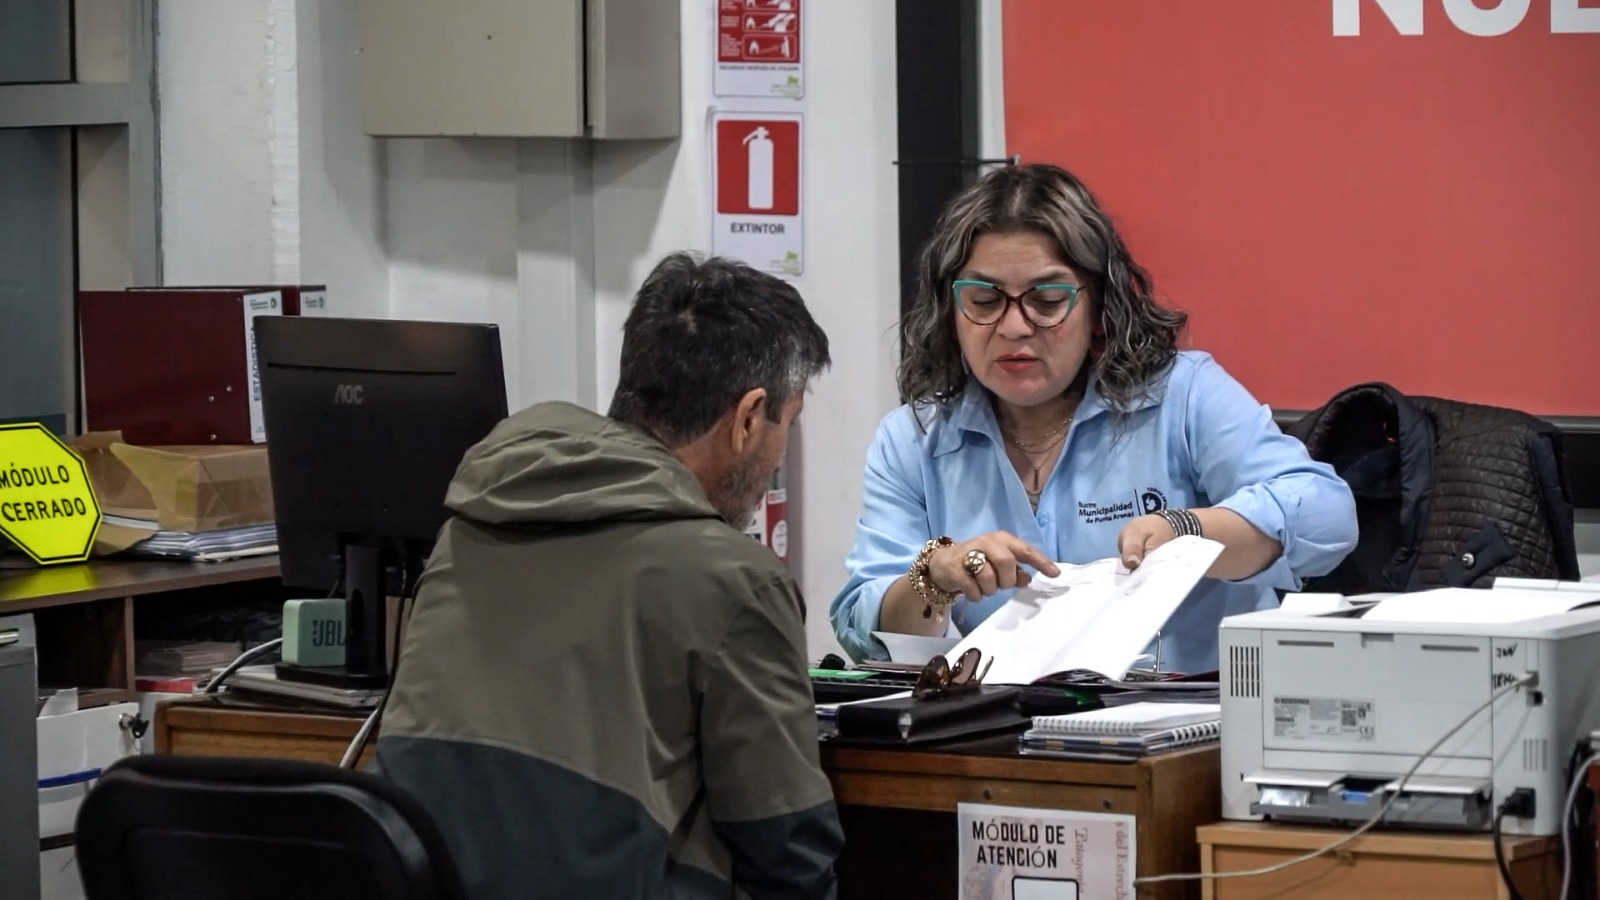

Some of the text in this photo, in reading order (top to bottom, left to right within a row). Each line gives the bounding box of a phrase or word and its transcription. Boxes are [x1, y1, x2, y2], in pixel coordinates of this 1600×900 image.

[730, 222, 785, 235] EXTINTOR
[334, 383, 364, 404] AOC
[0, 462, 70, 489] MÓDULO
[1, 497, 86, 522] CERRADO
[1079, 501, 1132, 516] Municipalidad
[1095, 515, 1111, 523] Punta
[1113, 511, 1133, 520] Arenas
[312, 619, 345, 647] JBL
[972, 818, 1065, 846] MÓDULO DE
[977, 845, 1058, 869] ATENCIÓN
